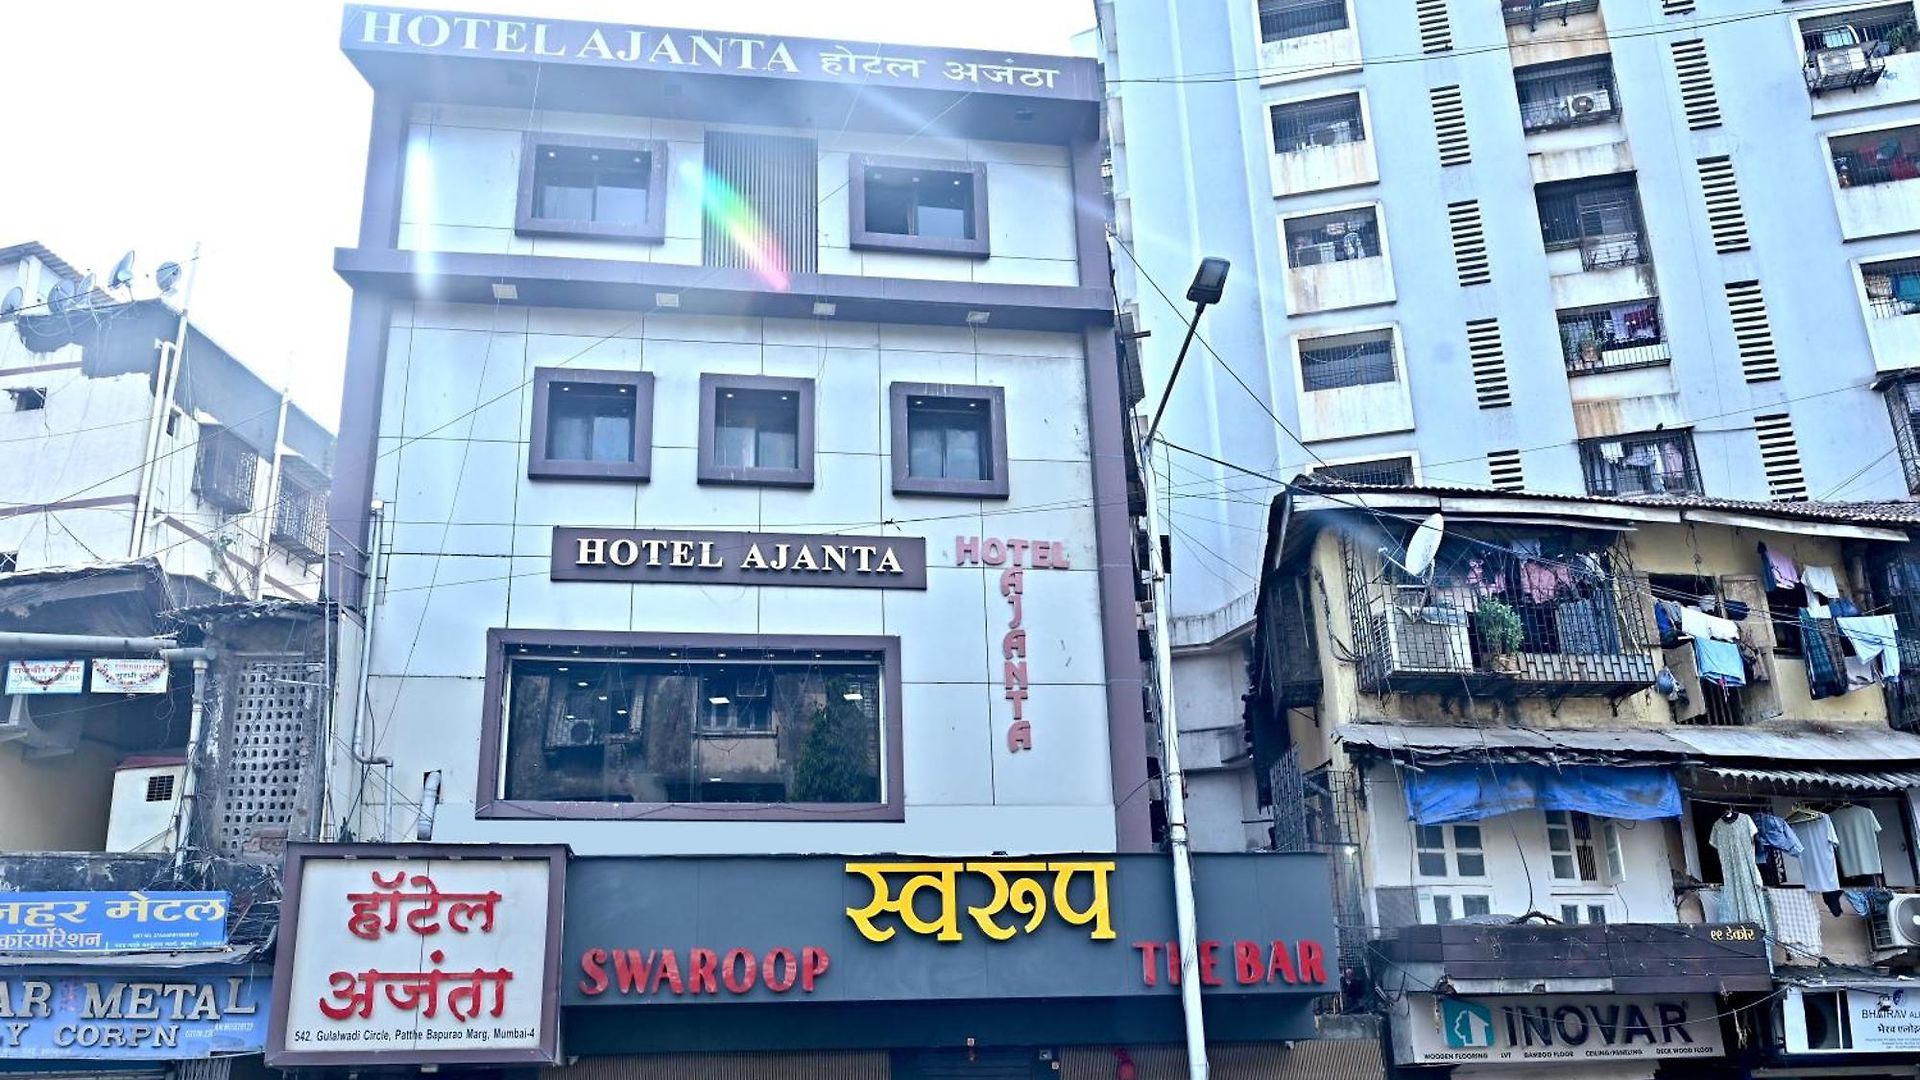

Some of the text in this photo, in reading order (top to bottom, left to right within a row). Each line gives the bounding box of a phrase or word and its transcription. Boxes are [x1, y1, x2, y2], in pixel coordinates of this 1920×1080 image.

[361, 10, 800, 74] HOTEL AJANTA
[819, 44, 1060, 89] होटल अजंठा
[576, 537, 904, 573] HOTEL AJANTA
[955, 535, 1070, 569] HOTEL
[999, 568, 1032, 753] AJANTA
[105, 891, 226, 923] मेटल
[346, 870, 502, 941] हॉटेल
[845, 862, 1117, 942] स्वरूप
[319, 949, 513, 1022] अजंता
[578, 946, 830, 994] SWAROOP
[1234, 939, 1327, 985] BAR
[80, 978, 256, 1021] METAL
[1861, 1008, 1907, 1019] BHAIRAV
[54, 1023, 181, 1048] CORPN
[316, 1031, 361, 1042] Gulalwadi
[363, 1030, 391, 1042] Circle,
[395, 1030, 423, 1041] Patthe
[426, 1029, 463, 1041] Bapurao
[466, 1029, 490, 1042] Marg,
[493, 1028, 536, 1039] Mumbai-4
[1504, 1002, 1694, 1047] INOVAR
